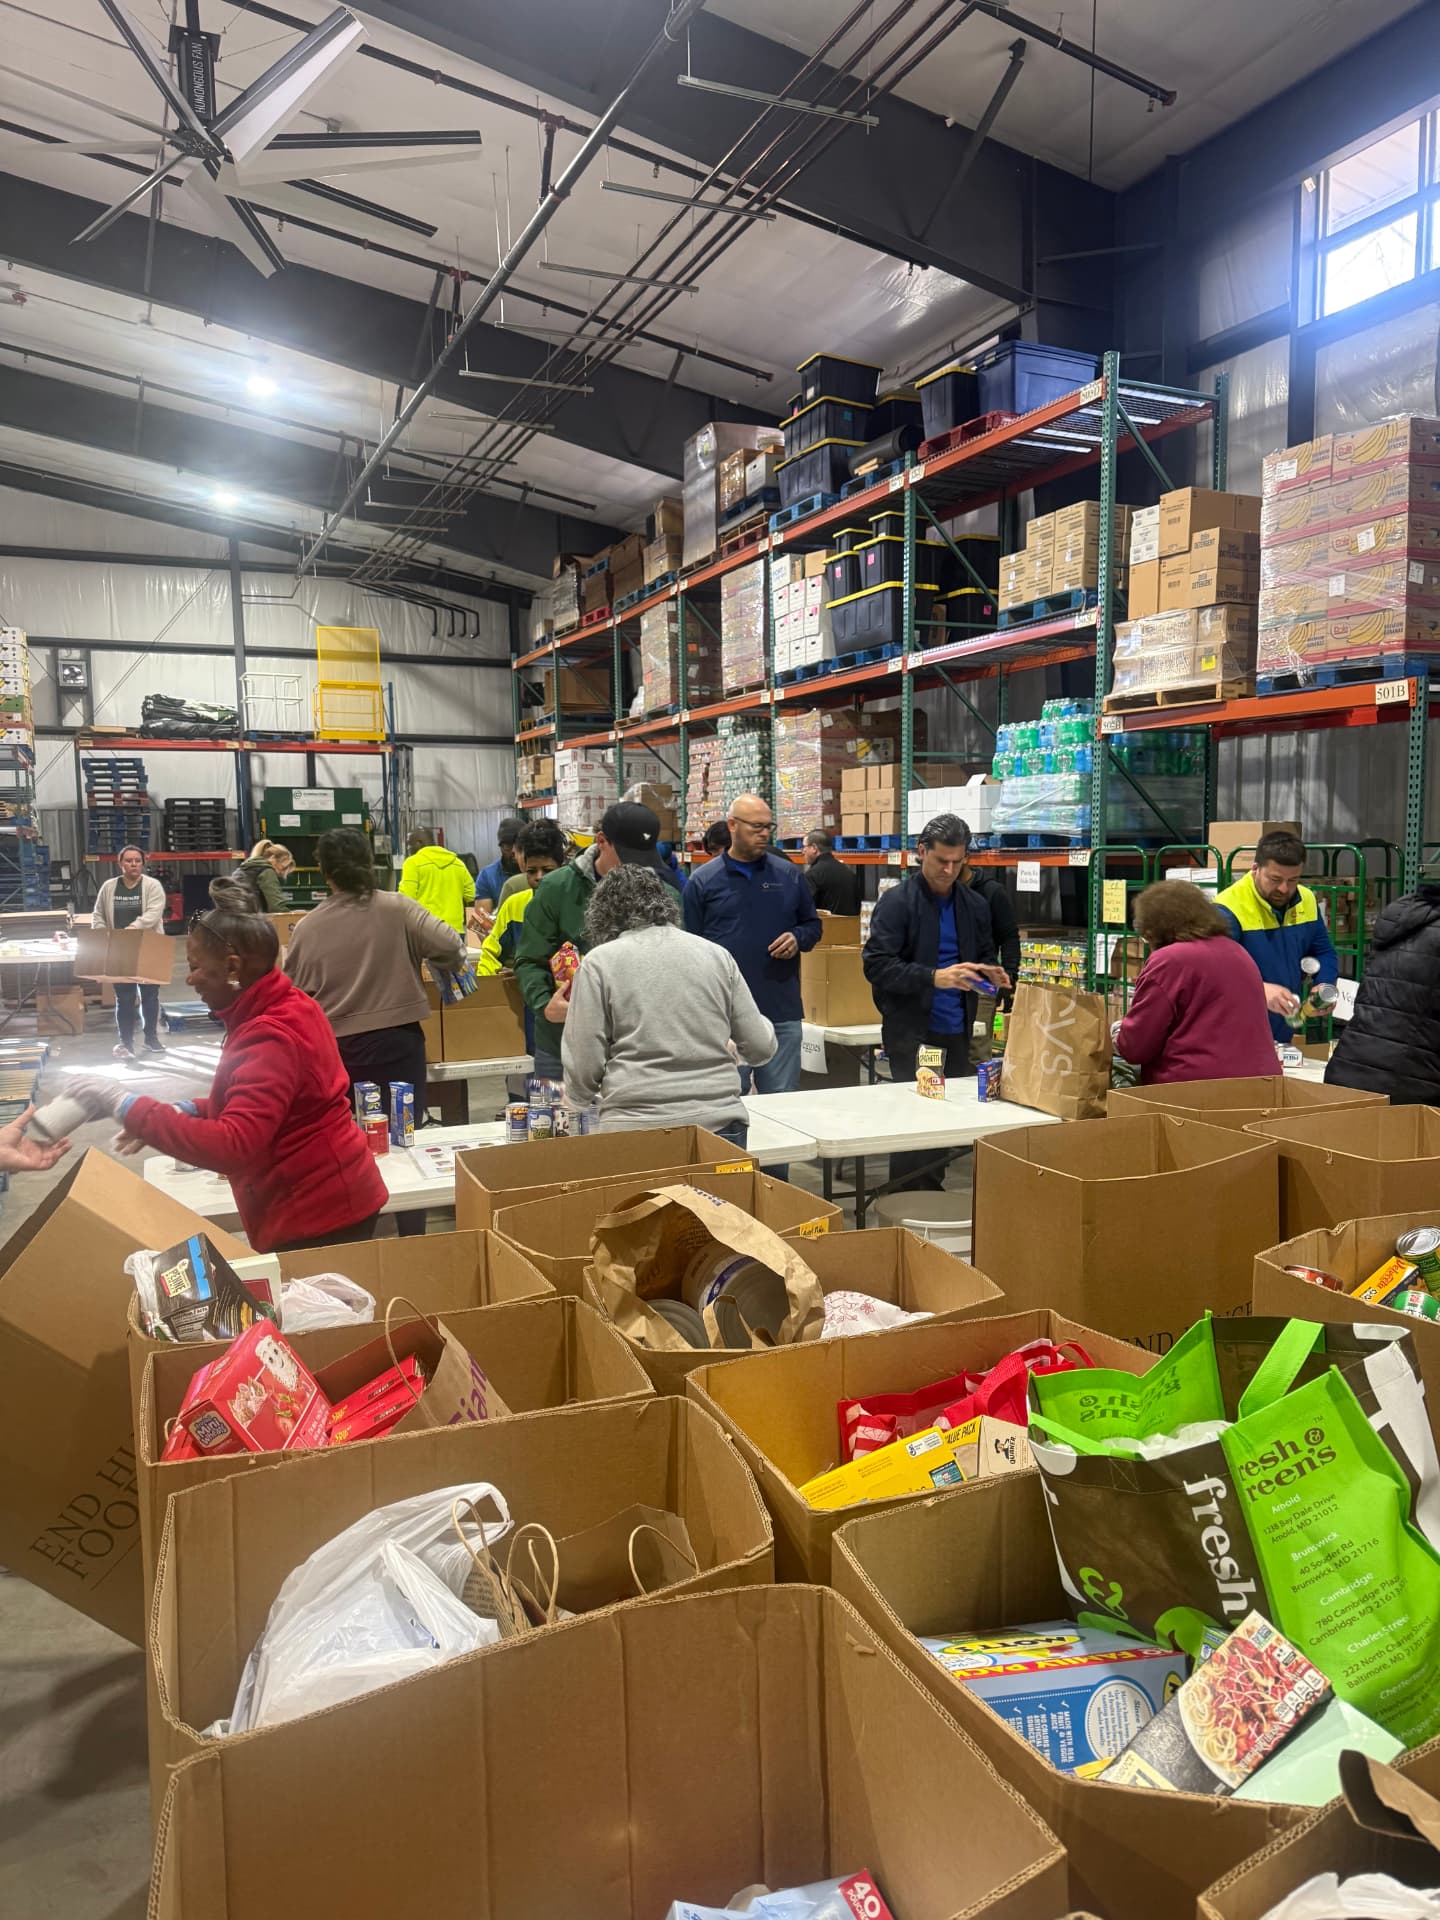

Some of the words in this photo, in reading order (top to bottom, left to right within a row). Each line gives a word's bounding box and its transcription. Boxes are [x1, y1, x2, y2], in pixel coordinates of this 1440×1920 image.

[191, 42, 204, 59] FAN
[193, 60, 206, 114] HUMONGOUS
[1376, 684, 1406, 701] 501B
[197, 1415, 221, 1438] Mini
[962, 1423, 977, 1440] PACK
[1245, 1446, 1337, 1502] reen's
[1271, 1494, 1301, 1514] Arnold
[1279, 1516, 1294, 1531] Bay
[1294, 1506, 1312, 1521] Dale
[1313, 1494, 1337, 1509] Drive
[30, 1493, 102, 1562] END
[1297, 1519, 1313, 1533] MD
[1314, 1503, 1340, 1522] 21012
[1183, 1474, 1257, 1615] fresh
[1291, 1531, 1338, 1562] Brunswick
[1334, 1554, 1351, 1570] MD
[1352, 1538, 1380, 1559] 21716
[1340, 1541, 1354, 1553] Rd
[1320, 1572, 1374, 1606] Cambridge
[1316, 1614, 1334, 1629] 780
[1333, 1588, 1380, 1618] Cambridge
[1358, 1604, 1374, 1619] MD
[1036, 1649, 1138, 1669] FAMILY
[1343, 1663, 1361, 1678] 222
[1360, 1650, 1386, 1668] North
[1390, 1651, 1406, 1666] MD
[953, 1663, 1028, 1680] PACK
[1033, 1715, 1042, 1747] ARTIFICIAL
[1057, 1711, 1066, 1729] FRUIT
[1063, 1711, 1071, 1730] MADE
[1042, 1723, 1050, 1748] COLORS
[1065, 1730, 1073, 1746] WITH
[1060, 1739, 1068, 1763] VEGGIE
[1067, 1747, 1075, 1763] REAL
[852, 1881, 881, 1919] 40
